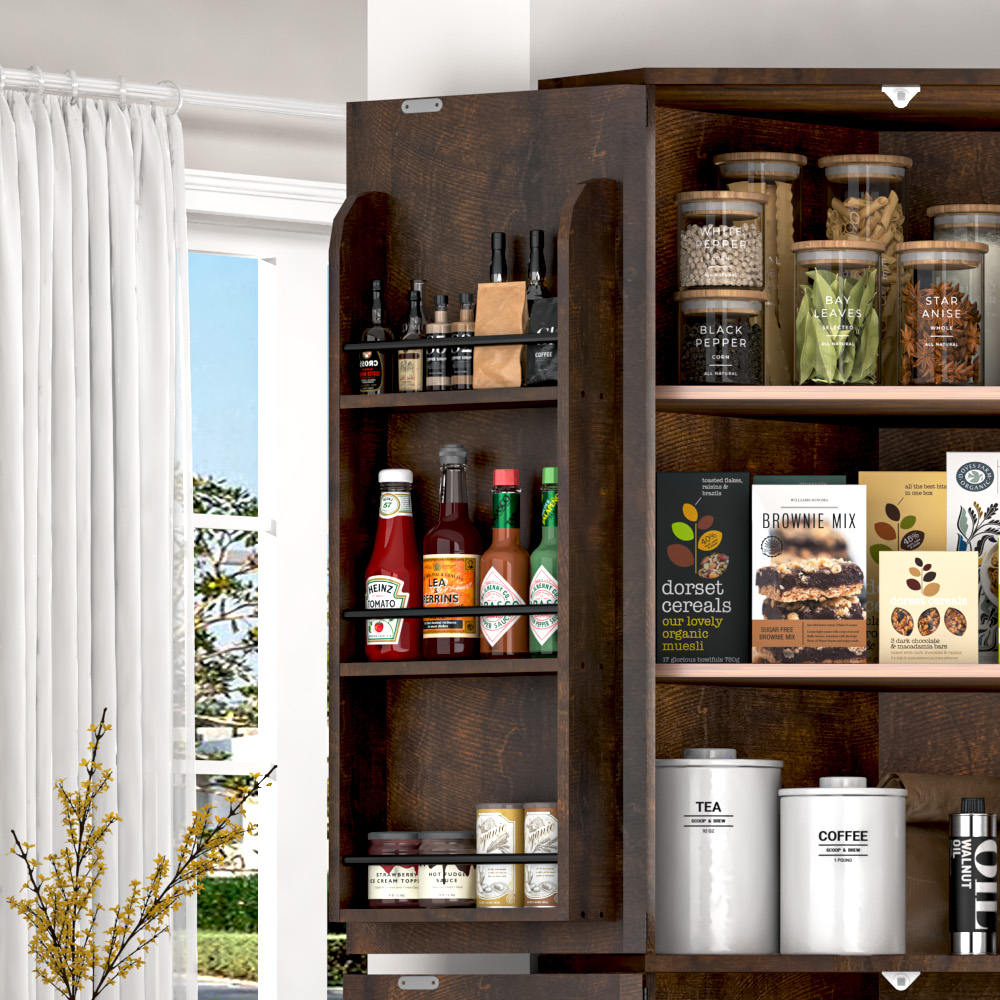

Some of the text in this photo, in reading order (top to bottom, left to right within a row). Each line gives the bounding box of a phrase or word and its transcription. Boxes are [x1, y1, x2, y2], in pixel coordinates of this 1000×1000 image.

[700, 227, 742, 236] WHITE
[696, 240, 746, 249] PEPPER
[825, 296, 851, 305] BAY
[925, 296, 958, 306] STAR
[814, 308, 862, 318] LEAVES
[922, 309, 962, 318] ANISE
[700, 326, 742, 335] BLACK
[696, 338, 746, 348] PEPPER
[959, 464, 992, 479] DOVES FARM
[960, 480, 991, 490] ORGANIC
[762, 513, 856, 528] BROWNIE MIX
[701, 532, 717, 544] 40%
[428, 578, 446, 587] LEA
[662, 580, 724, 595] dorset
[368, 584, 393, 594] HEINZ
[368, 600, 396, 608] TOMATO
[662, 598, 732, 613] cereals
[890, 596, 967, 605] dorset cereals
[662, 616, 724, 628] our lovely
[662, 628, 709, 640] organic
[662, 641, 704, 651] muesli
[696, 802, 721, 812] TEA
[818, 830, 868, 842] COFFEE
[953, 839, 961, 859] OIL
[961, 839, 972, 889] WALNUT
[974, 839, 997, 929] OIL
